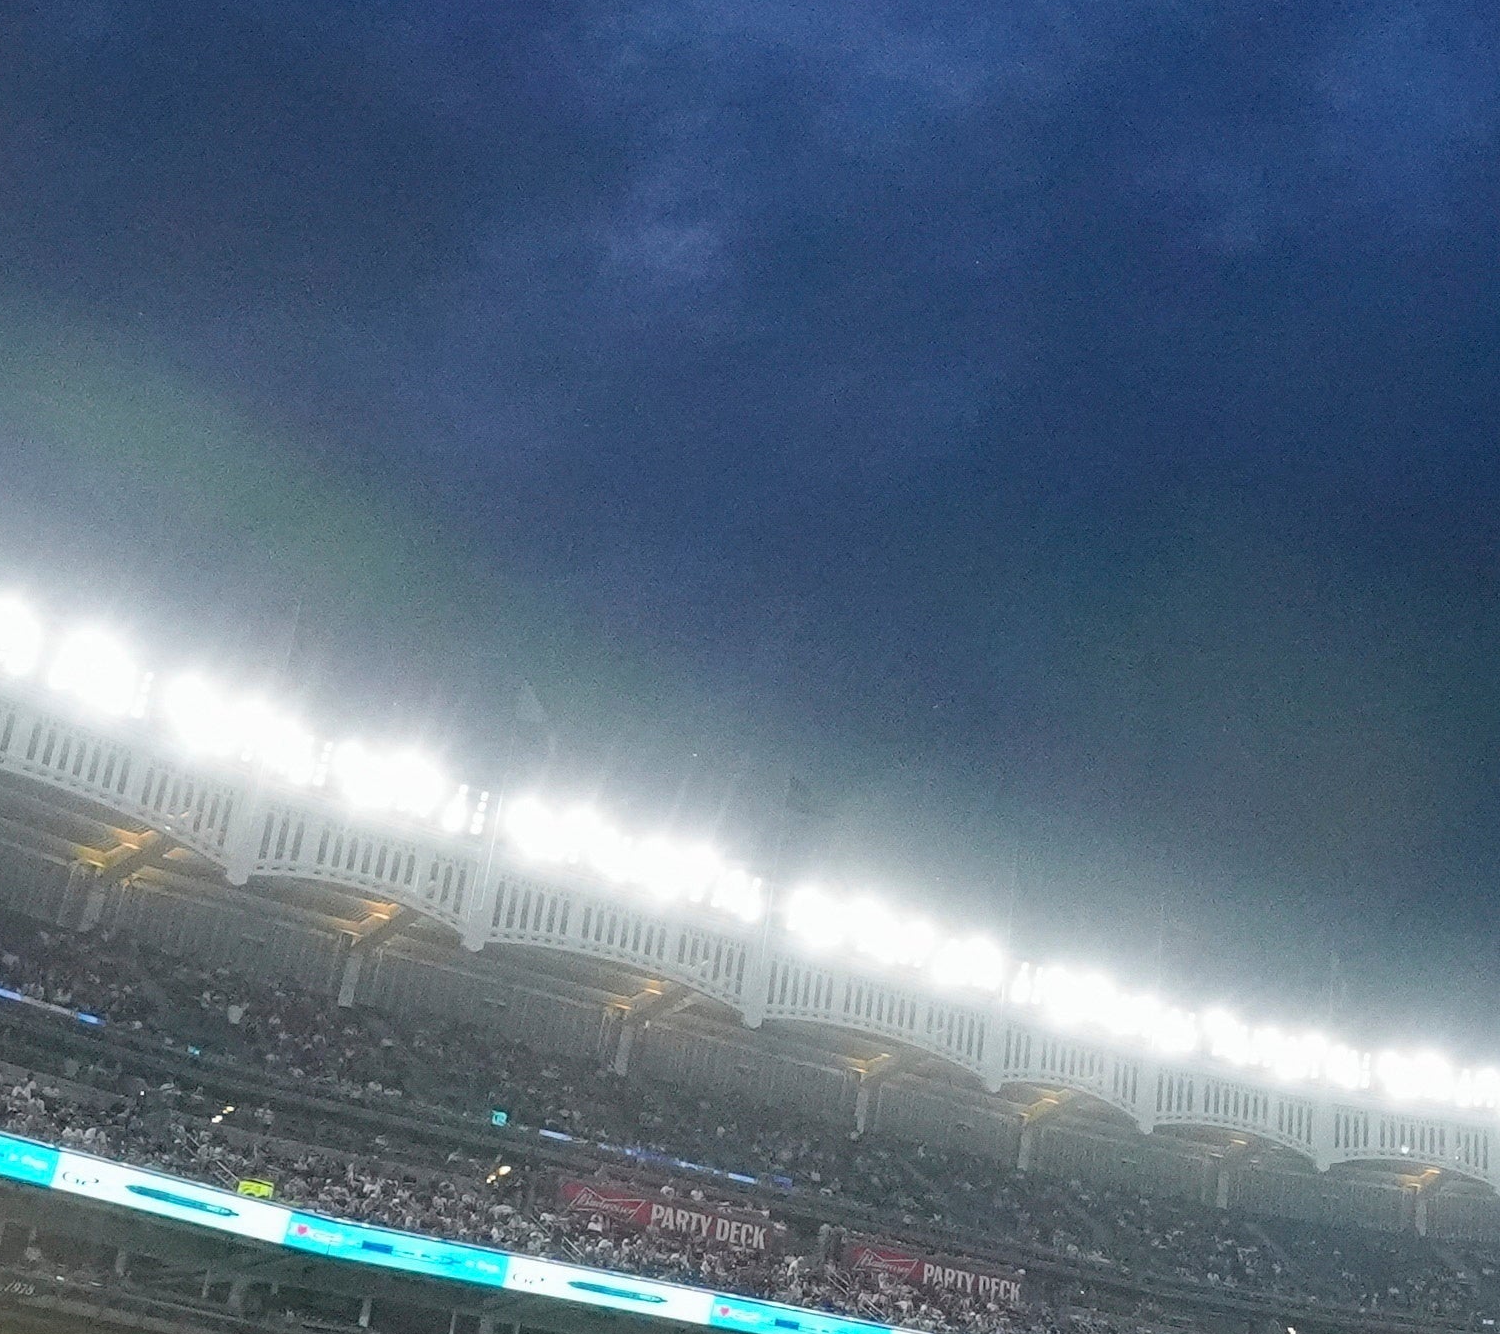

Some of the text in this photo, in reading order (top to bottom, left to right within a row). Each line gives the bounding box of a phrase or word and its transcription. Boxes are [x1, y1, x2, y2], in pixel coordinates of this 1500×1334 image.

[651, 1203, 768, 1250] PARTY DECK
[923, 1263, 975, 1293] PARTY
